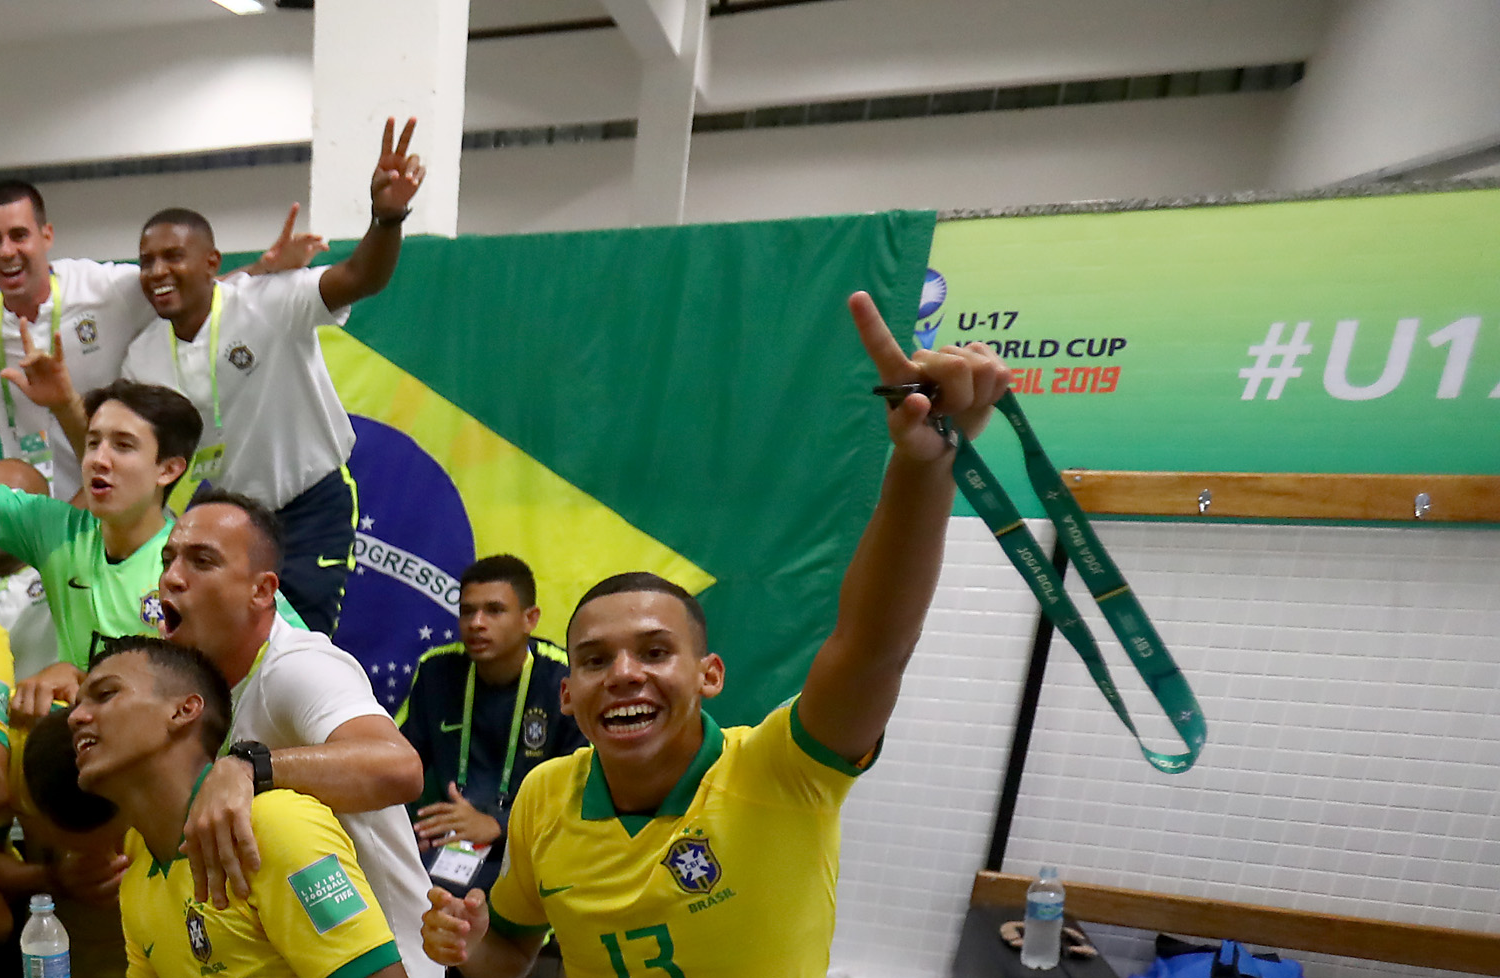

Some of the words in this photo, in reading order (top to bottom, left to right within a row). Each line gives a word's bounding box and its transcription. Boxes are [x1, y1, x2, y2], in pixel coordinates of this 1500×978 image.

[958, 311, 1019, 330] U-17
[955, 338, 1059, 358] ORLD
[1066, 337, 1127, 357] CUP
[1238, 316, 1500, 401] #U1
[1008, 368, 1045, 394] SIL
[1051, 366, 1121, 394] 2019
[353, 538, 461, 606] OGRESSO
[301, 871, 342, 897] LIVING
[304, 878, 347, 903] FOOTBALL
[334, 888, 354, 904] FIFA
[688, 887, 737, 914] BRASIL
